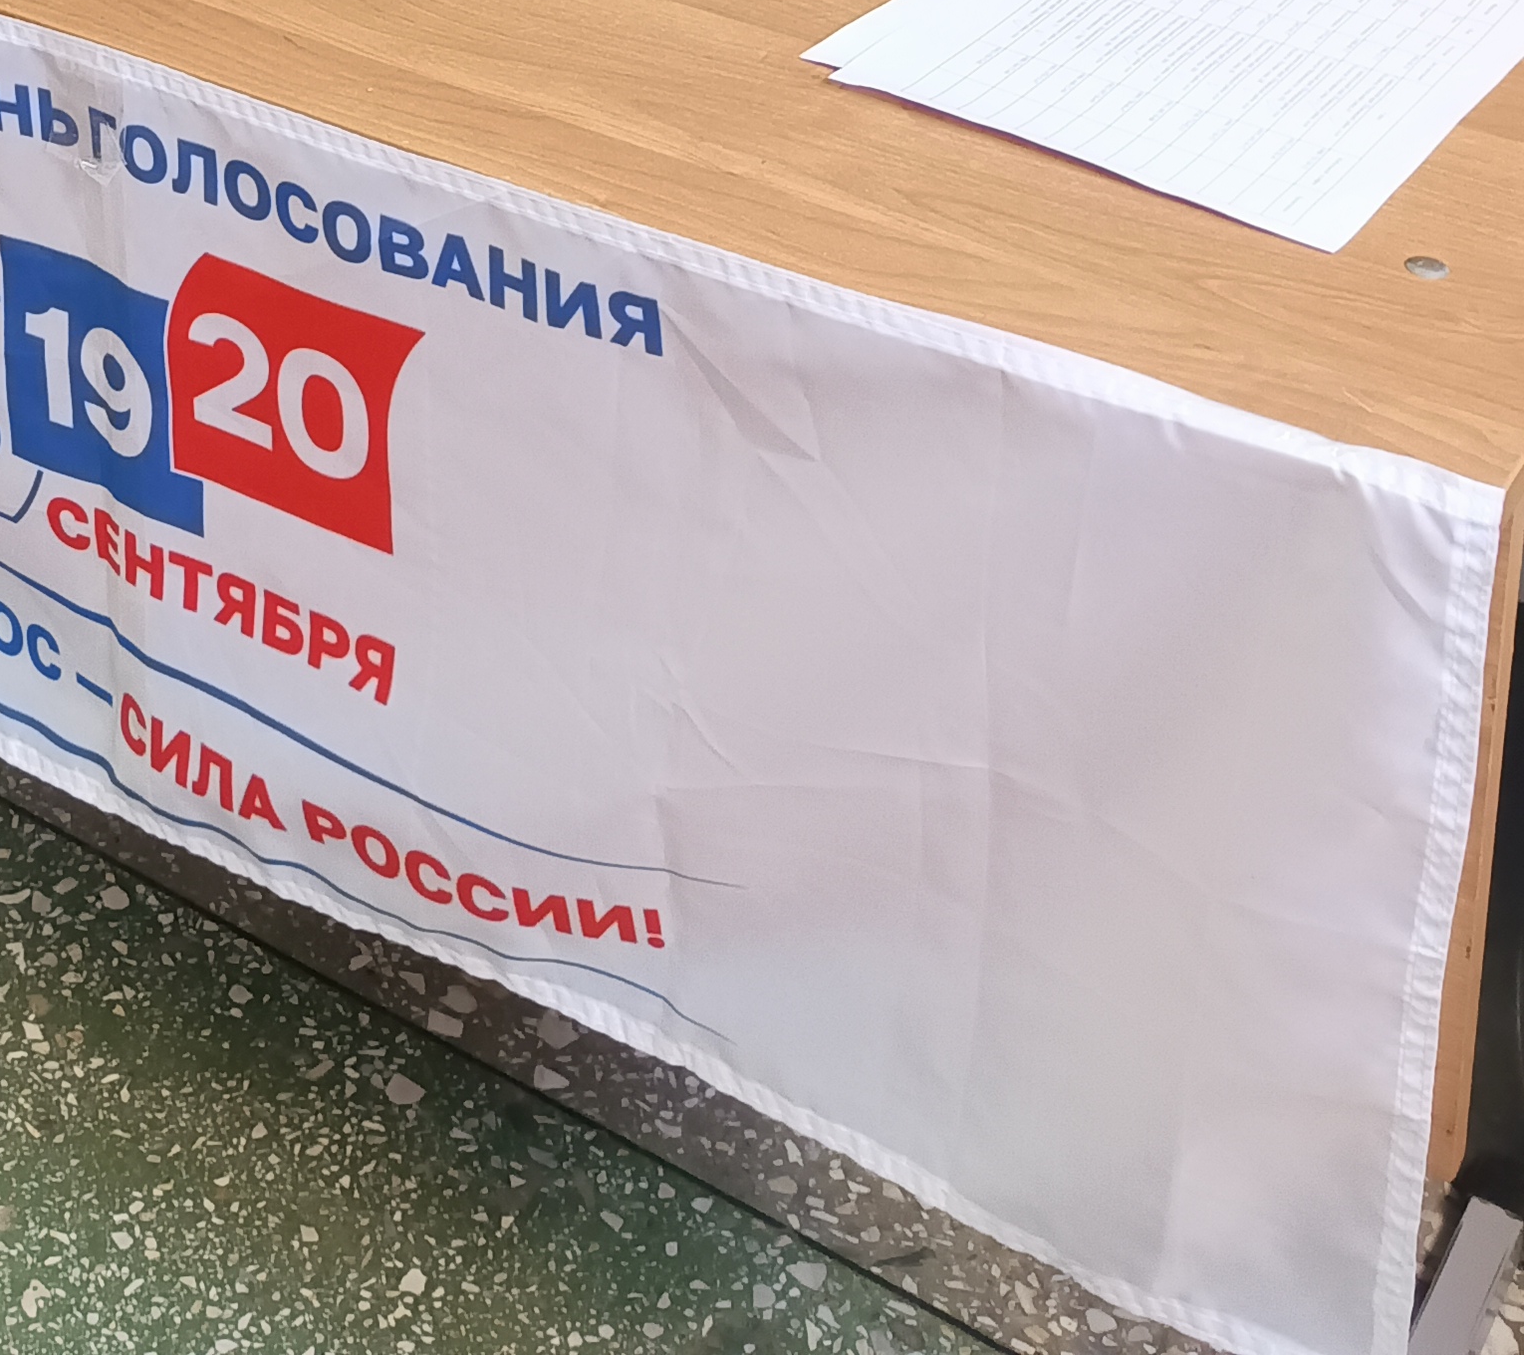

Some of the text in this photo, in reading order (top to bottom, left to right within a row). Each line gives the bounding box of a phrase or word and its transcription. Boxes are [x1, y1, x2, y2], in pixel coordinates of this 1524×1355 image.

[87, 105, 664, 358] ГОЛОСОВАНИЯ
[25, 306, 153, 459] 19
[187, 311, 370, 481] 20
[46, 495, 396, 707] СЕНТЯБРЯ
[119, 691, 288, 833] СИЛА
[299, 798, 667, 951] РОССИИ!
